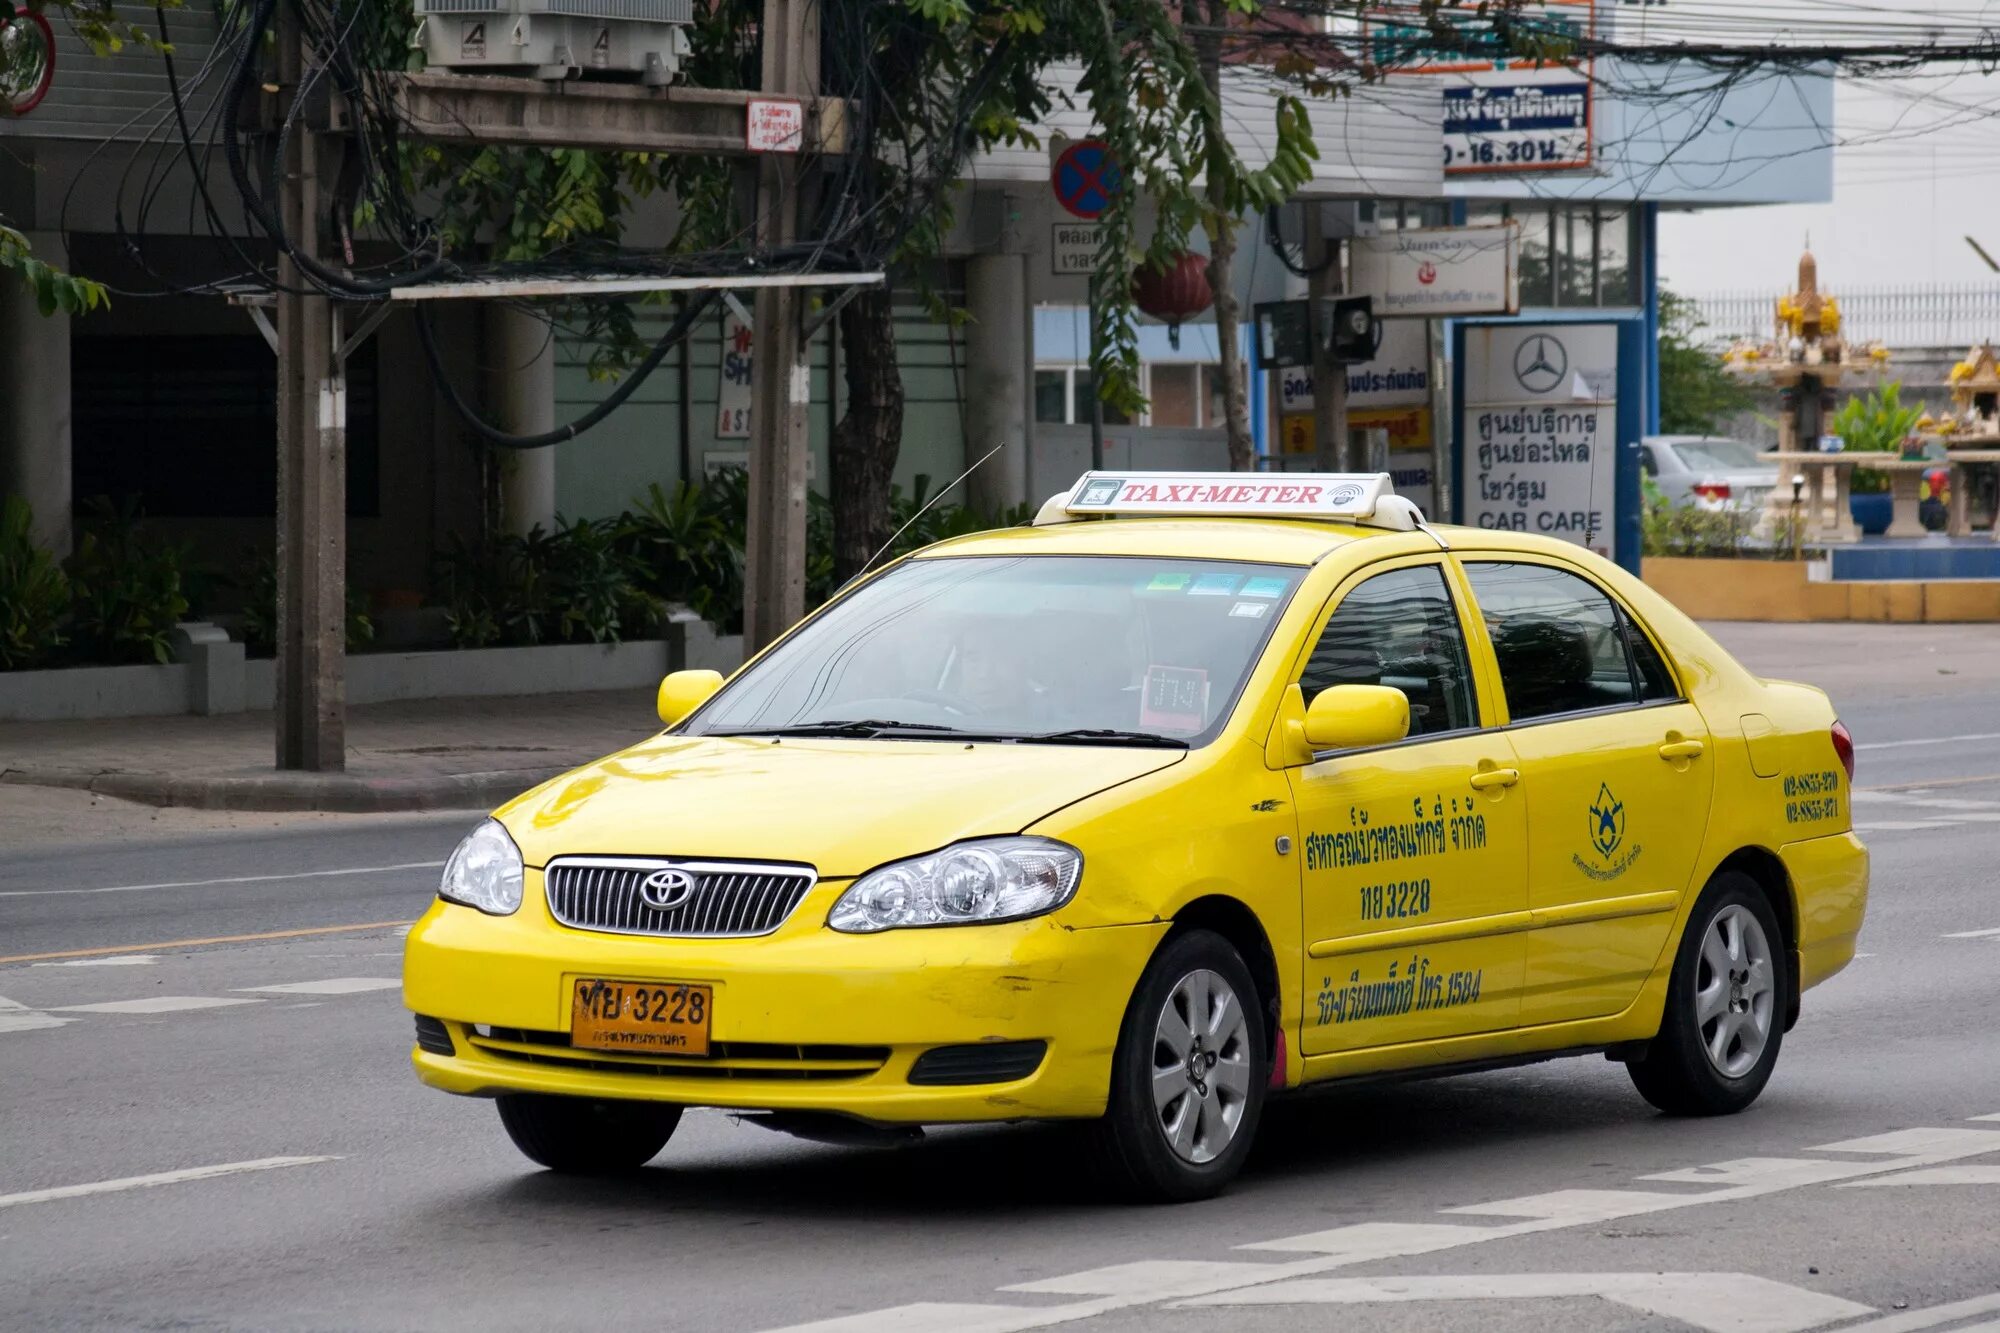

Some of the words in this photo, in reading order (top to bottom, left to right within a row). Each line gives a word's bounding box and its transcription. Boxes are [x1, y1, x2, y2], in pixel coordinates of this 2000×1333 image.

[1478, 406, 1596, 440] ศูนย์บริการ
[1478, 434, 1590, 471] ศูนย์อะไหล่
[1120, 484, 1323, 503] TAXI-METER
[1479, 512, 1527, 530] CAR
[1537, 511, 1603, 532] CARE
[1450, 796, 1487, 850] จำกัด
[1360, 885, 1383, 920] ทย
[1386, 878, 1431, 919] 3228
[633, 988, 705, 1025] 3228
